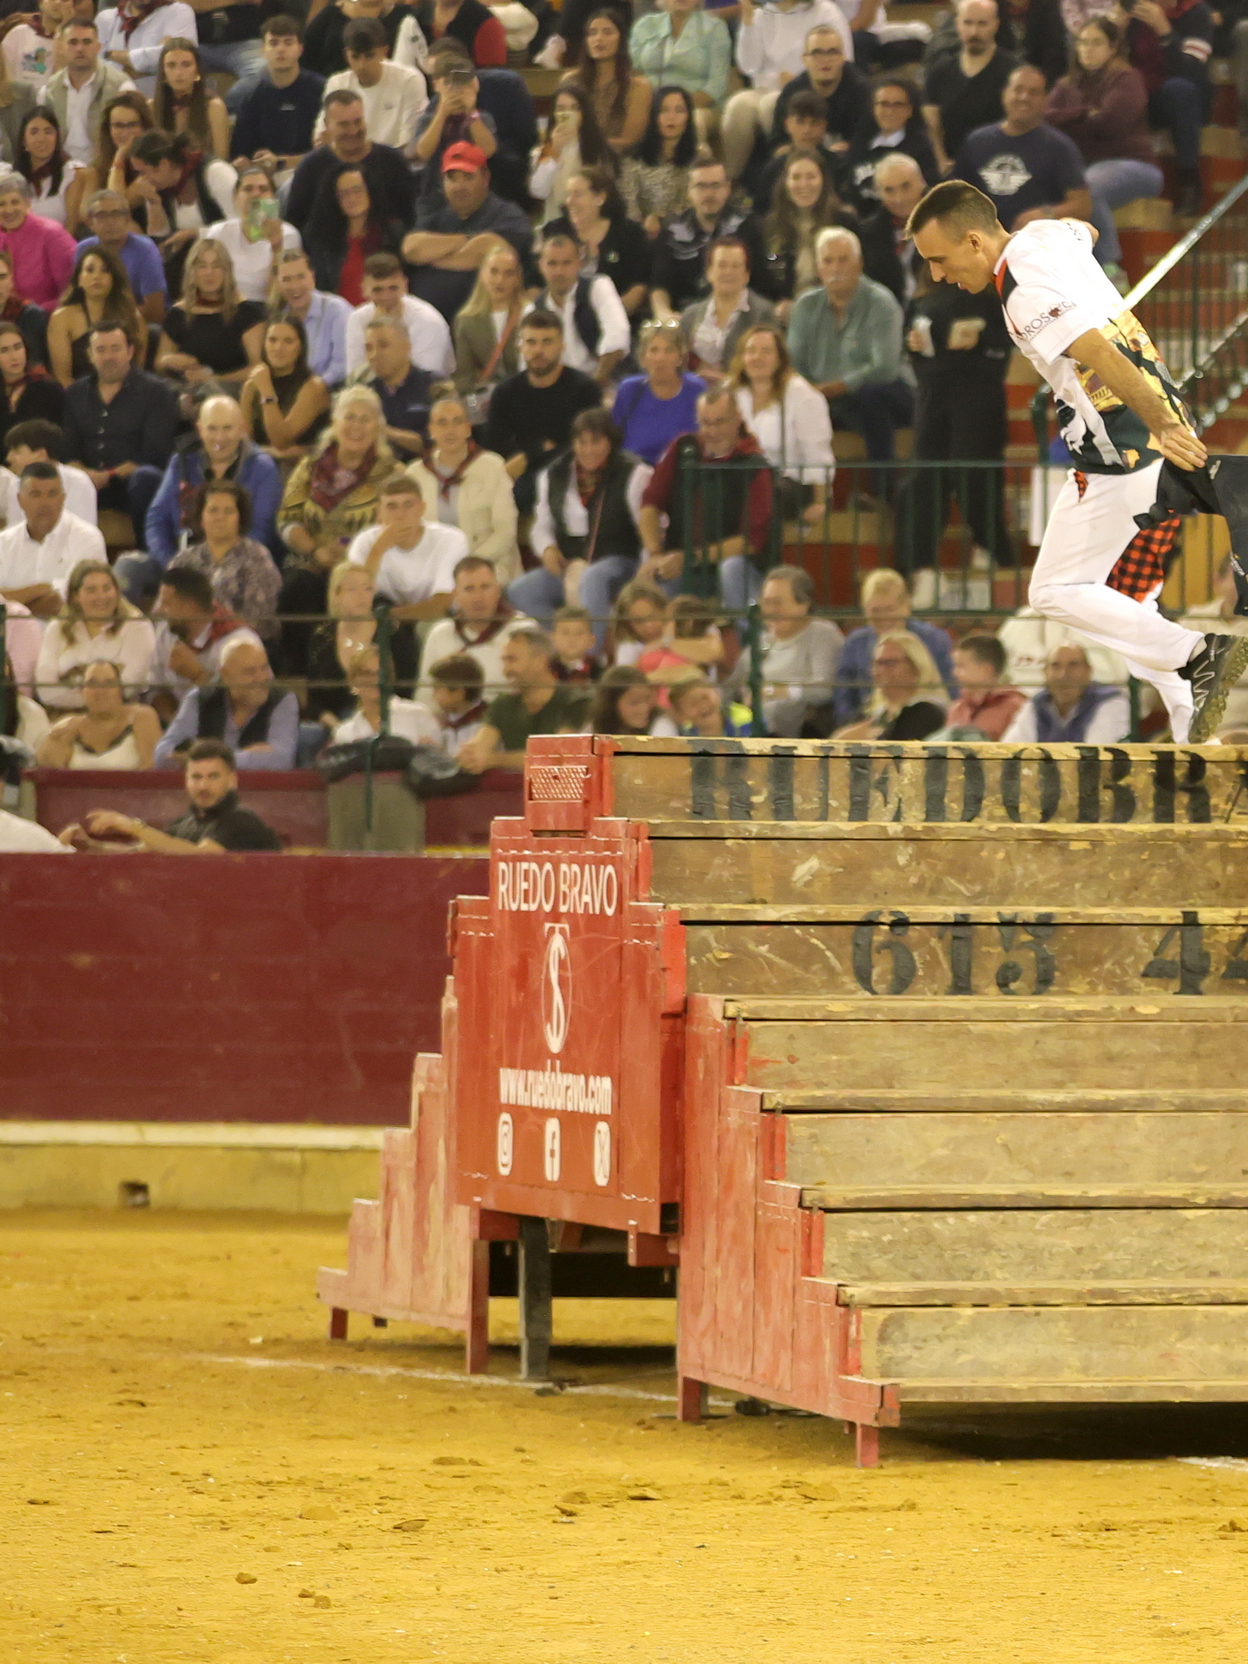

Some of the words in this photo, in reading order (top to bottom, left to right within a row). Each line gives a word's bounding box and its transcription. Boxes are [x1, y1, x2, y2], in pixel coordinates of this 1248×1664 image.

[498, 862, 555, 913] RUEDO
[559, 863, 618, 916] BRAVO
[852, 910, 1056, 995] 615
[499, 1059, 612, 1115] www.ruedobravo.com
